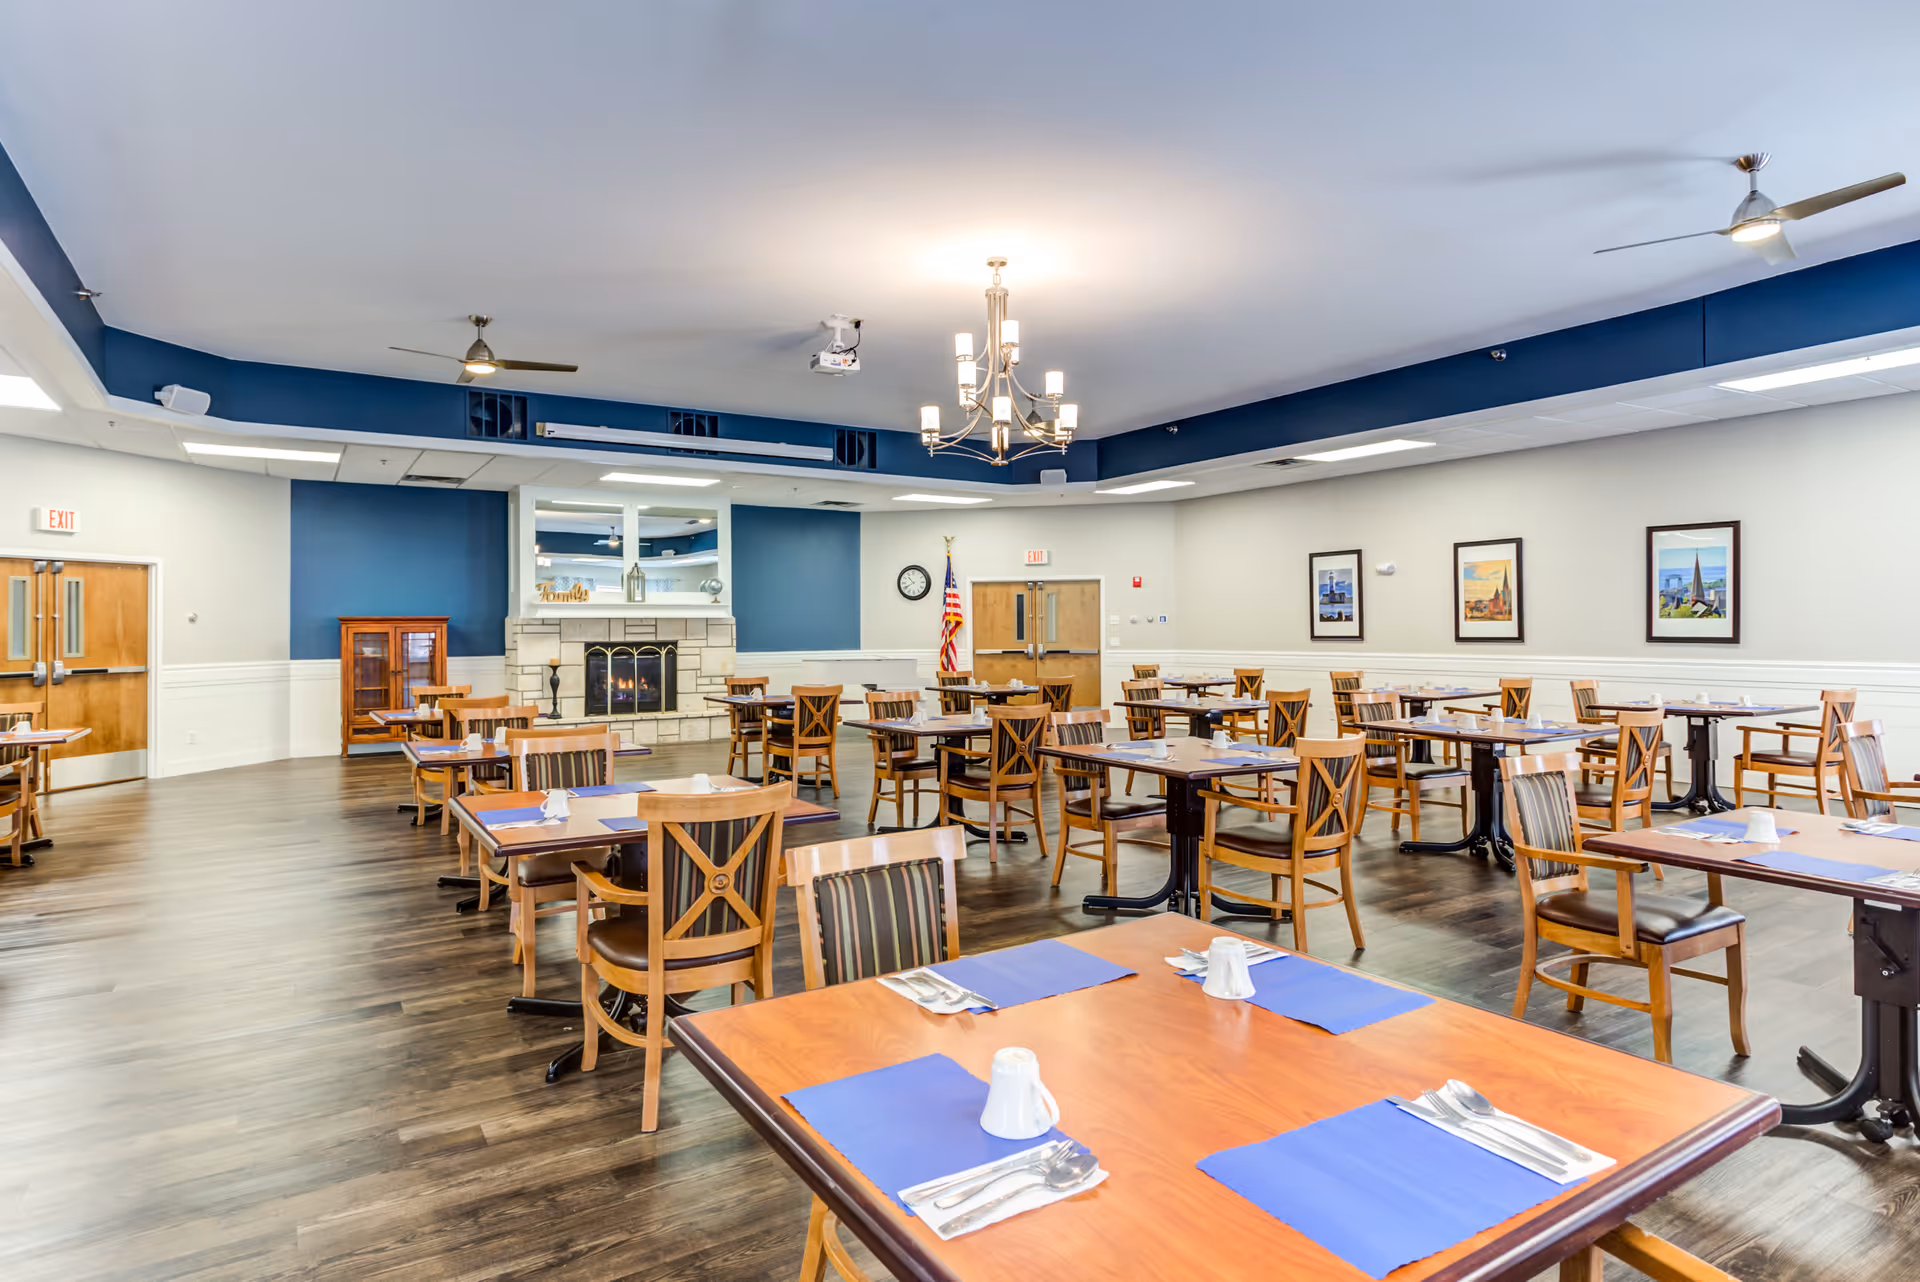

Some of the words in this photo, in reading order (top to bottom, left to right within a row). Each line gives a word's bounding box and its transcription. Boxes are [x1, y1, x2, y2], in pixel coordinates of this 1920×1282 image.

[49, 509, 75, 529] EXIT
[1027, 550, 1044, 563] EXIT
[535, 581, 589, 603] Family
